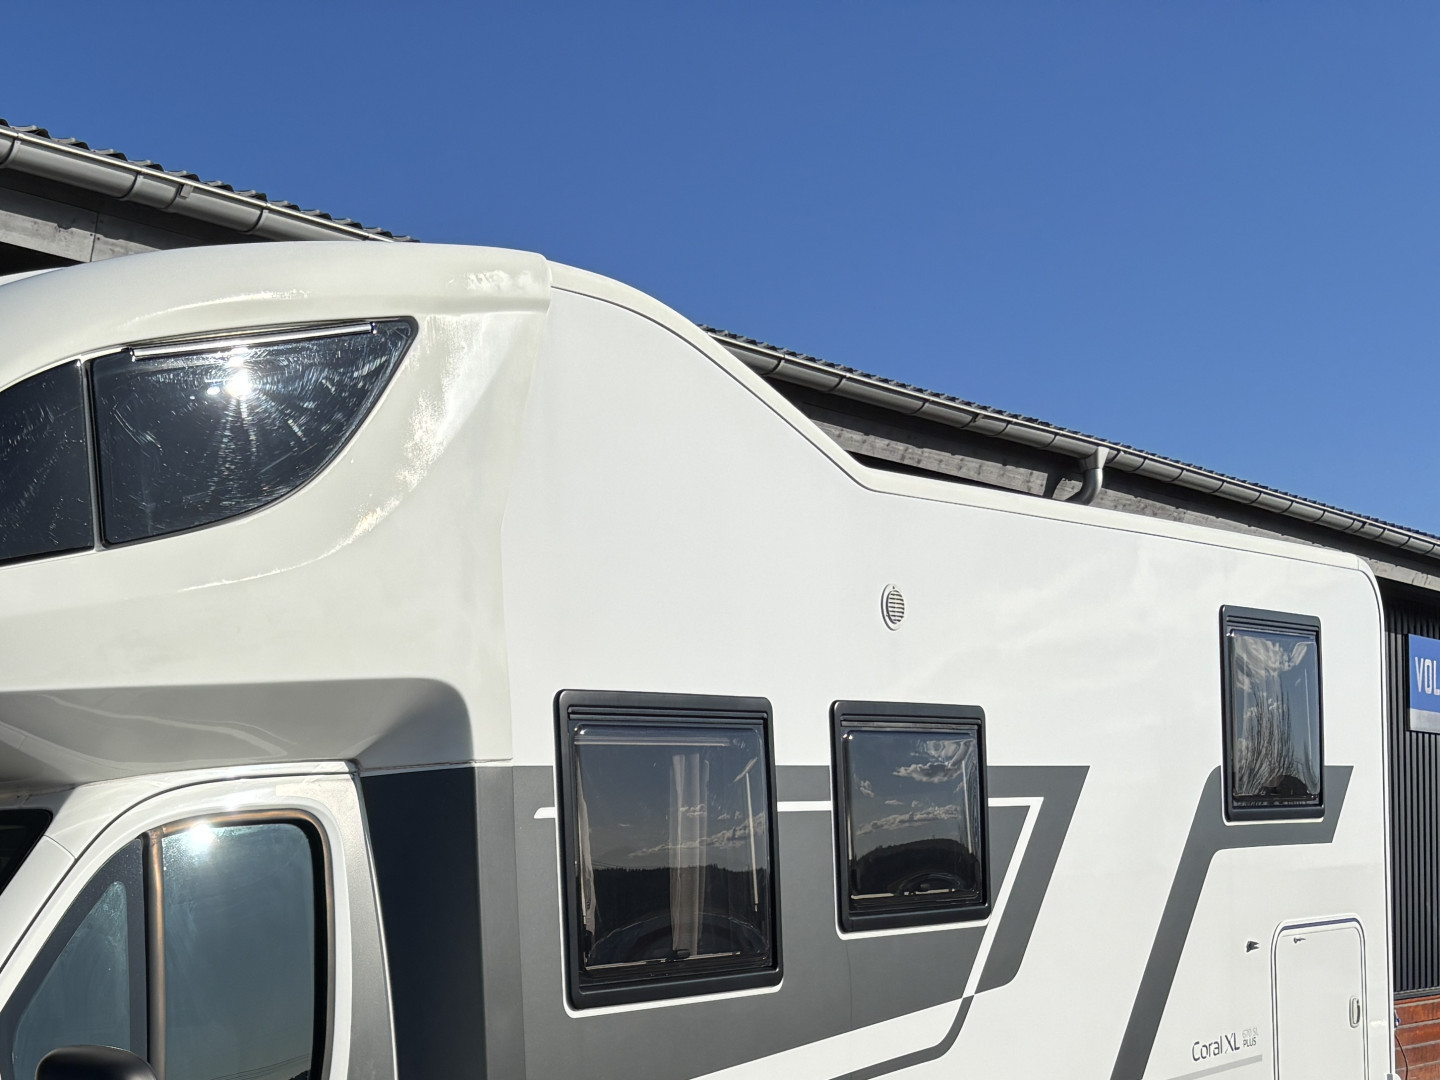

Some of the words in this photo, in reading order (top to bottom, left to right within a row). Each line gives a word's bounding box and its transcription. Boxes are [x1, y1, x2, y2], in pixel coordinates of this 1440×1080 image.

[1191, 1035, 1223, 1062] Coral
[1224, 1032, 1241, 1054] XL
[1242, 1036, 1257, 1048] PLUS
